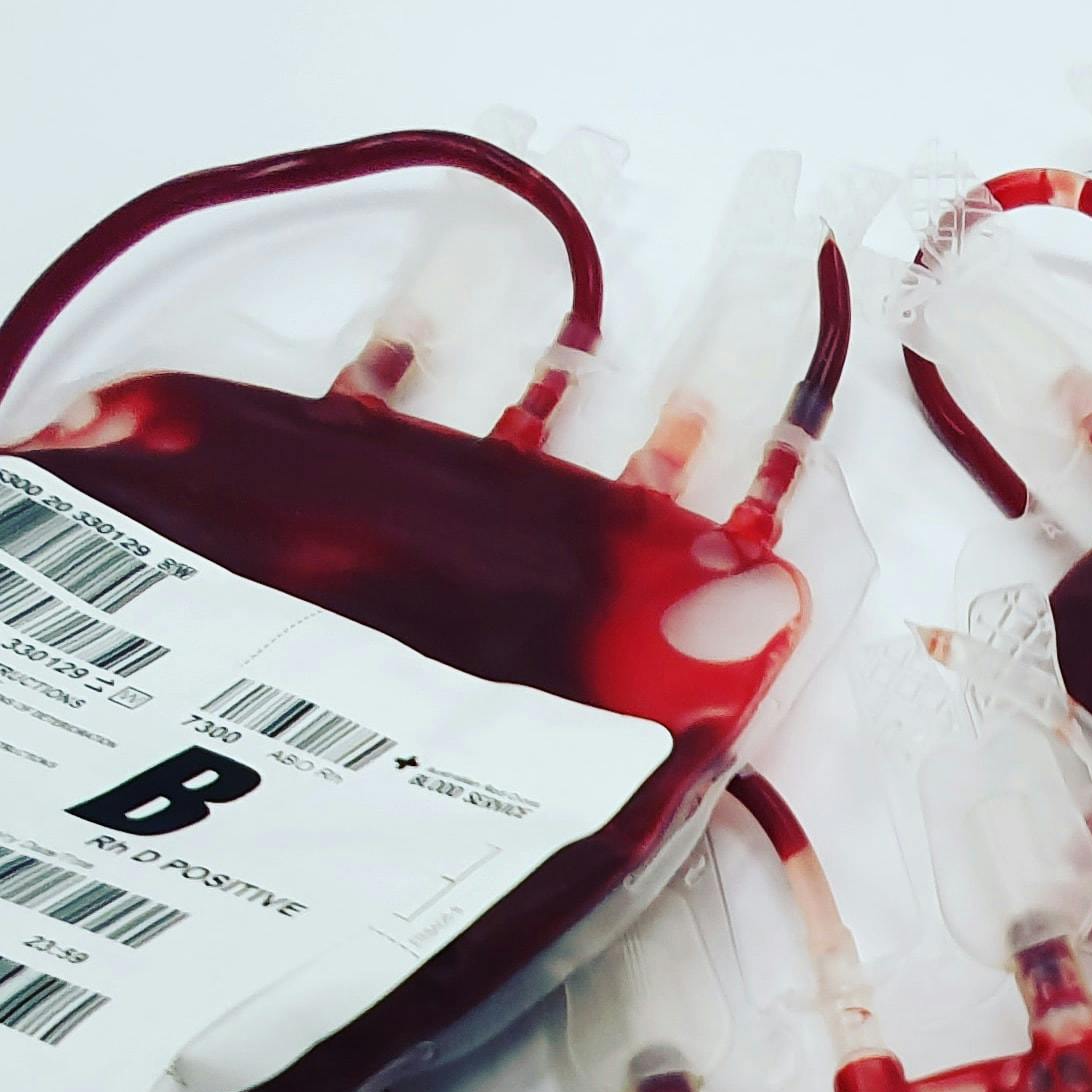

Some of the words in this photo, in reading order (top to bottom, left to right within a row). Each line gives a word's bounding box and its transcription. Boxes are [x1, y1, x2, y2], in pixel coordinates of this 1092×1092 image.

[43, 495, 73, 512] 20
[72, 510, 150, 557] 330129
[1, 638, 89, 679] 330129
[181, 714, 242, 744] 7300
[267, 750, 313, 772] ABO
[64, 744, 261, 836] B
[85, 834, 128, 852] Rh
[131, 850, 161, 862] D
[160, 859, 309, 918] POSITIVE
